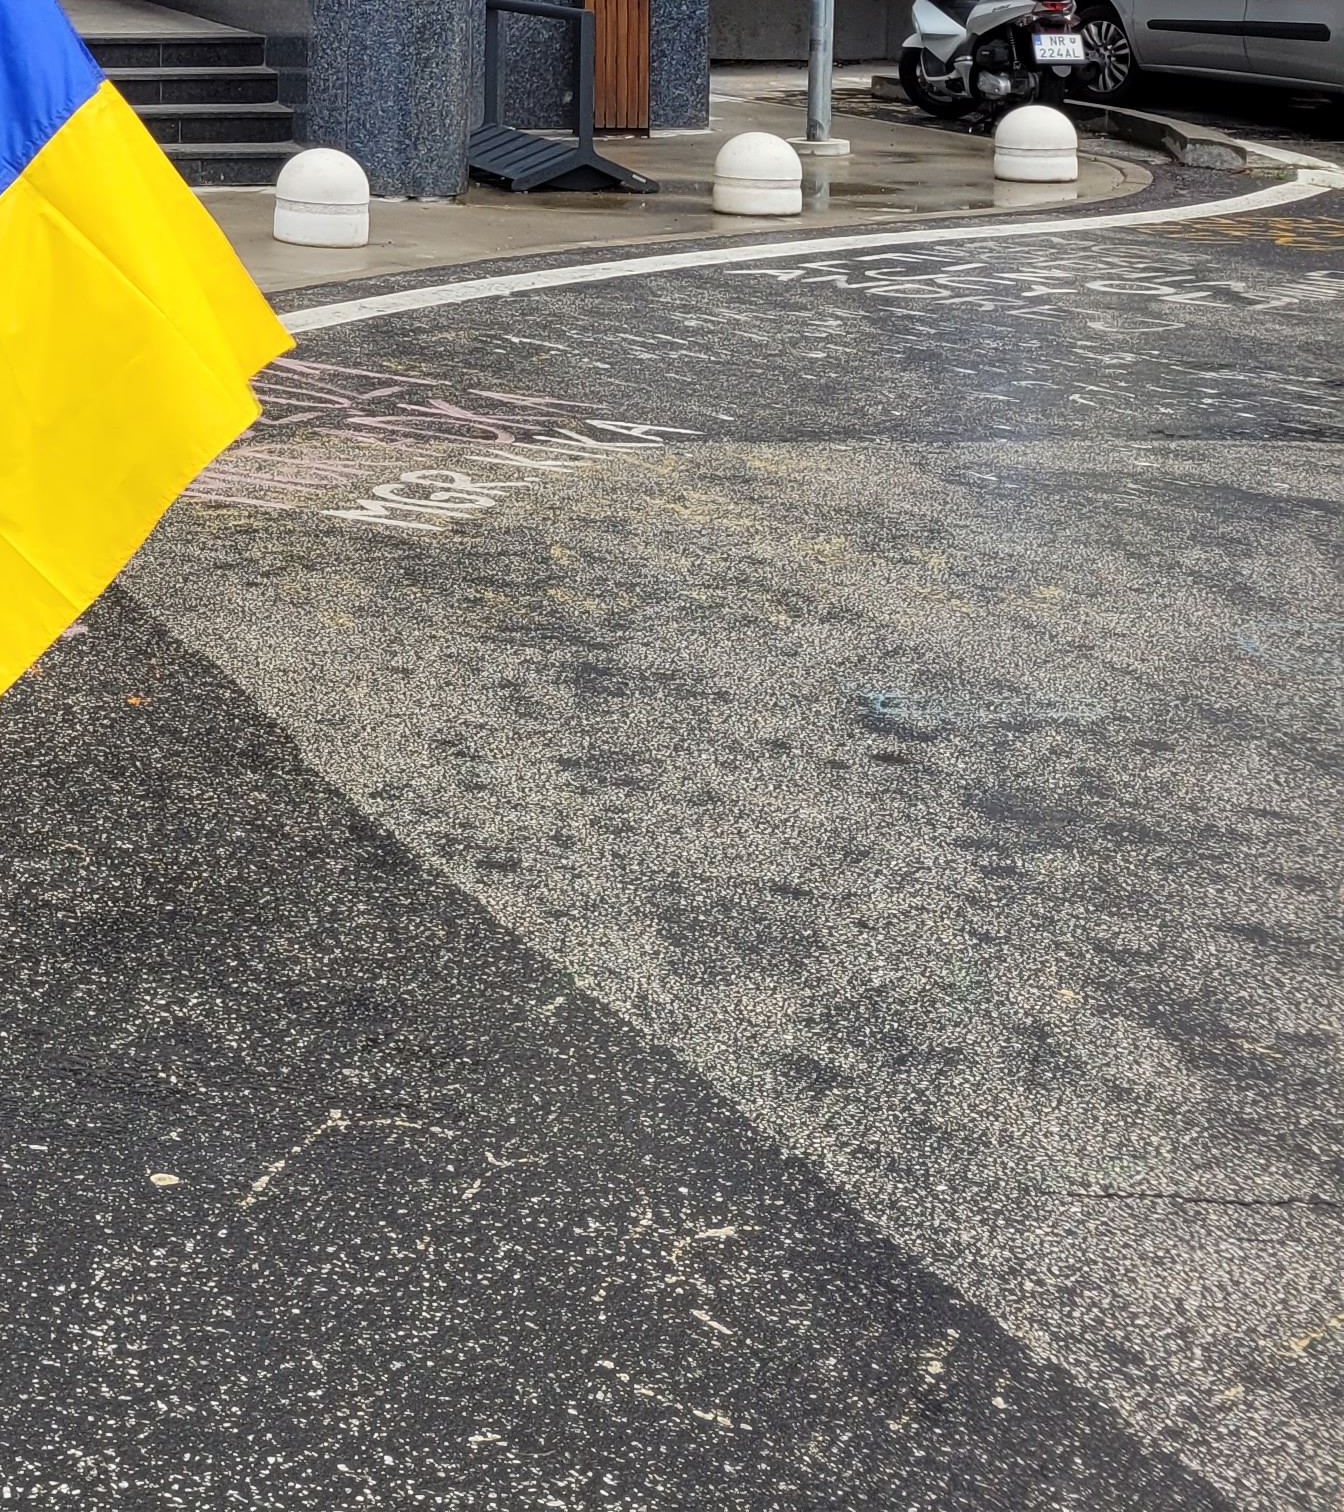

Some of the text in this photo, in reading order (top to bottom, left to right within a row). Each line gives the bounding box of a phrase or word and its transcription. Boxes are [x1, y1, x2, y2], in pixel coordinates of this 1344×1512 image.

[1049, 35, 1065, 46] NR
[1040, 48, 1080, 59] 224AL
[797, 260, 1078, 297] LUCY
[321, 420, 708, 531] MGR. KIKA
